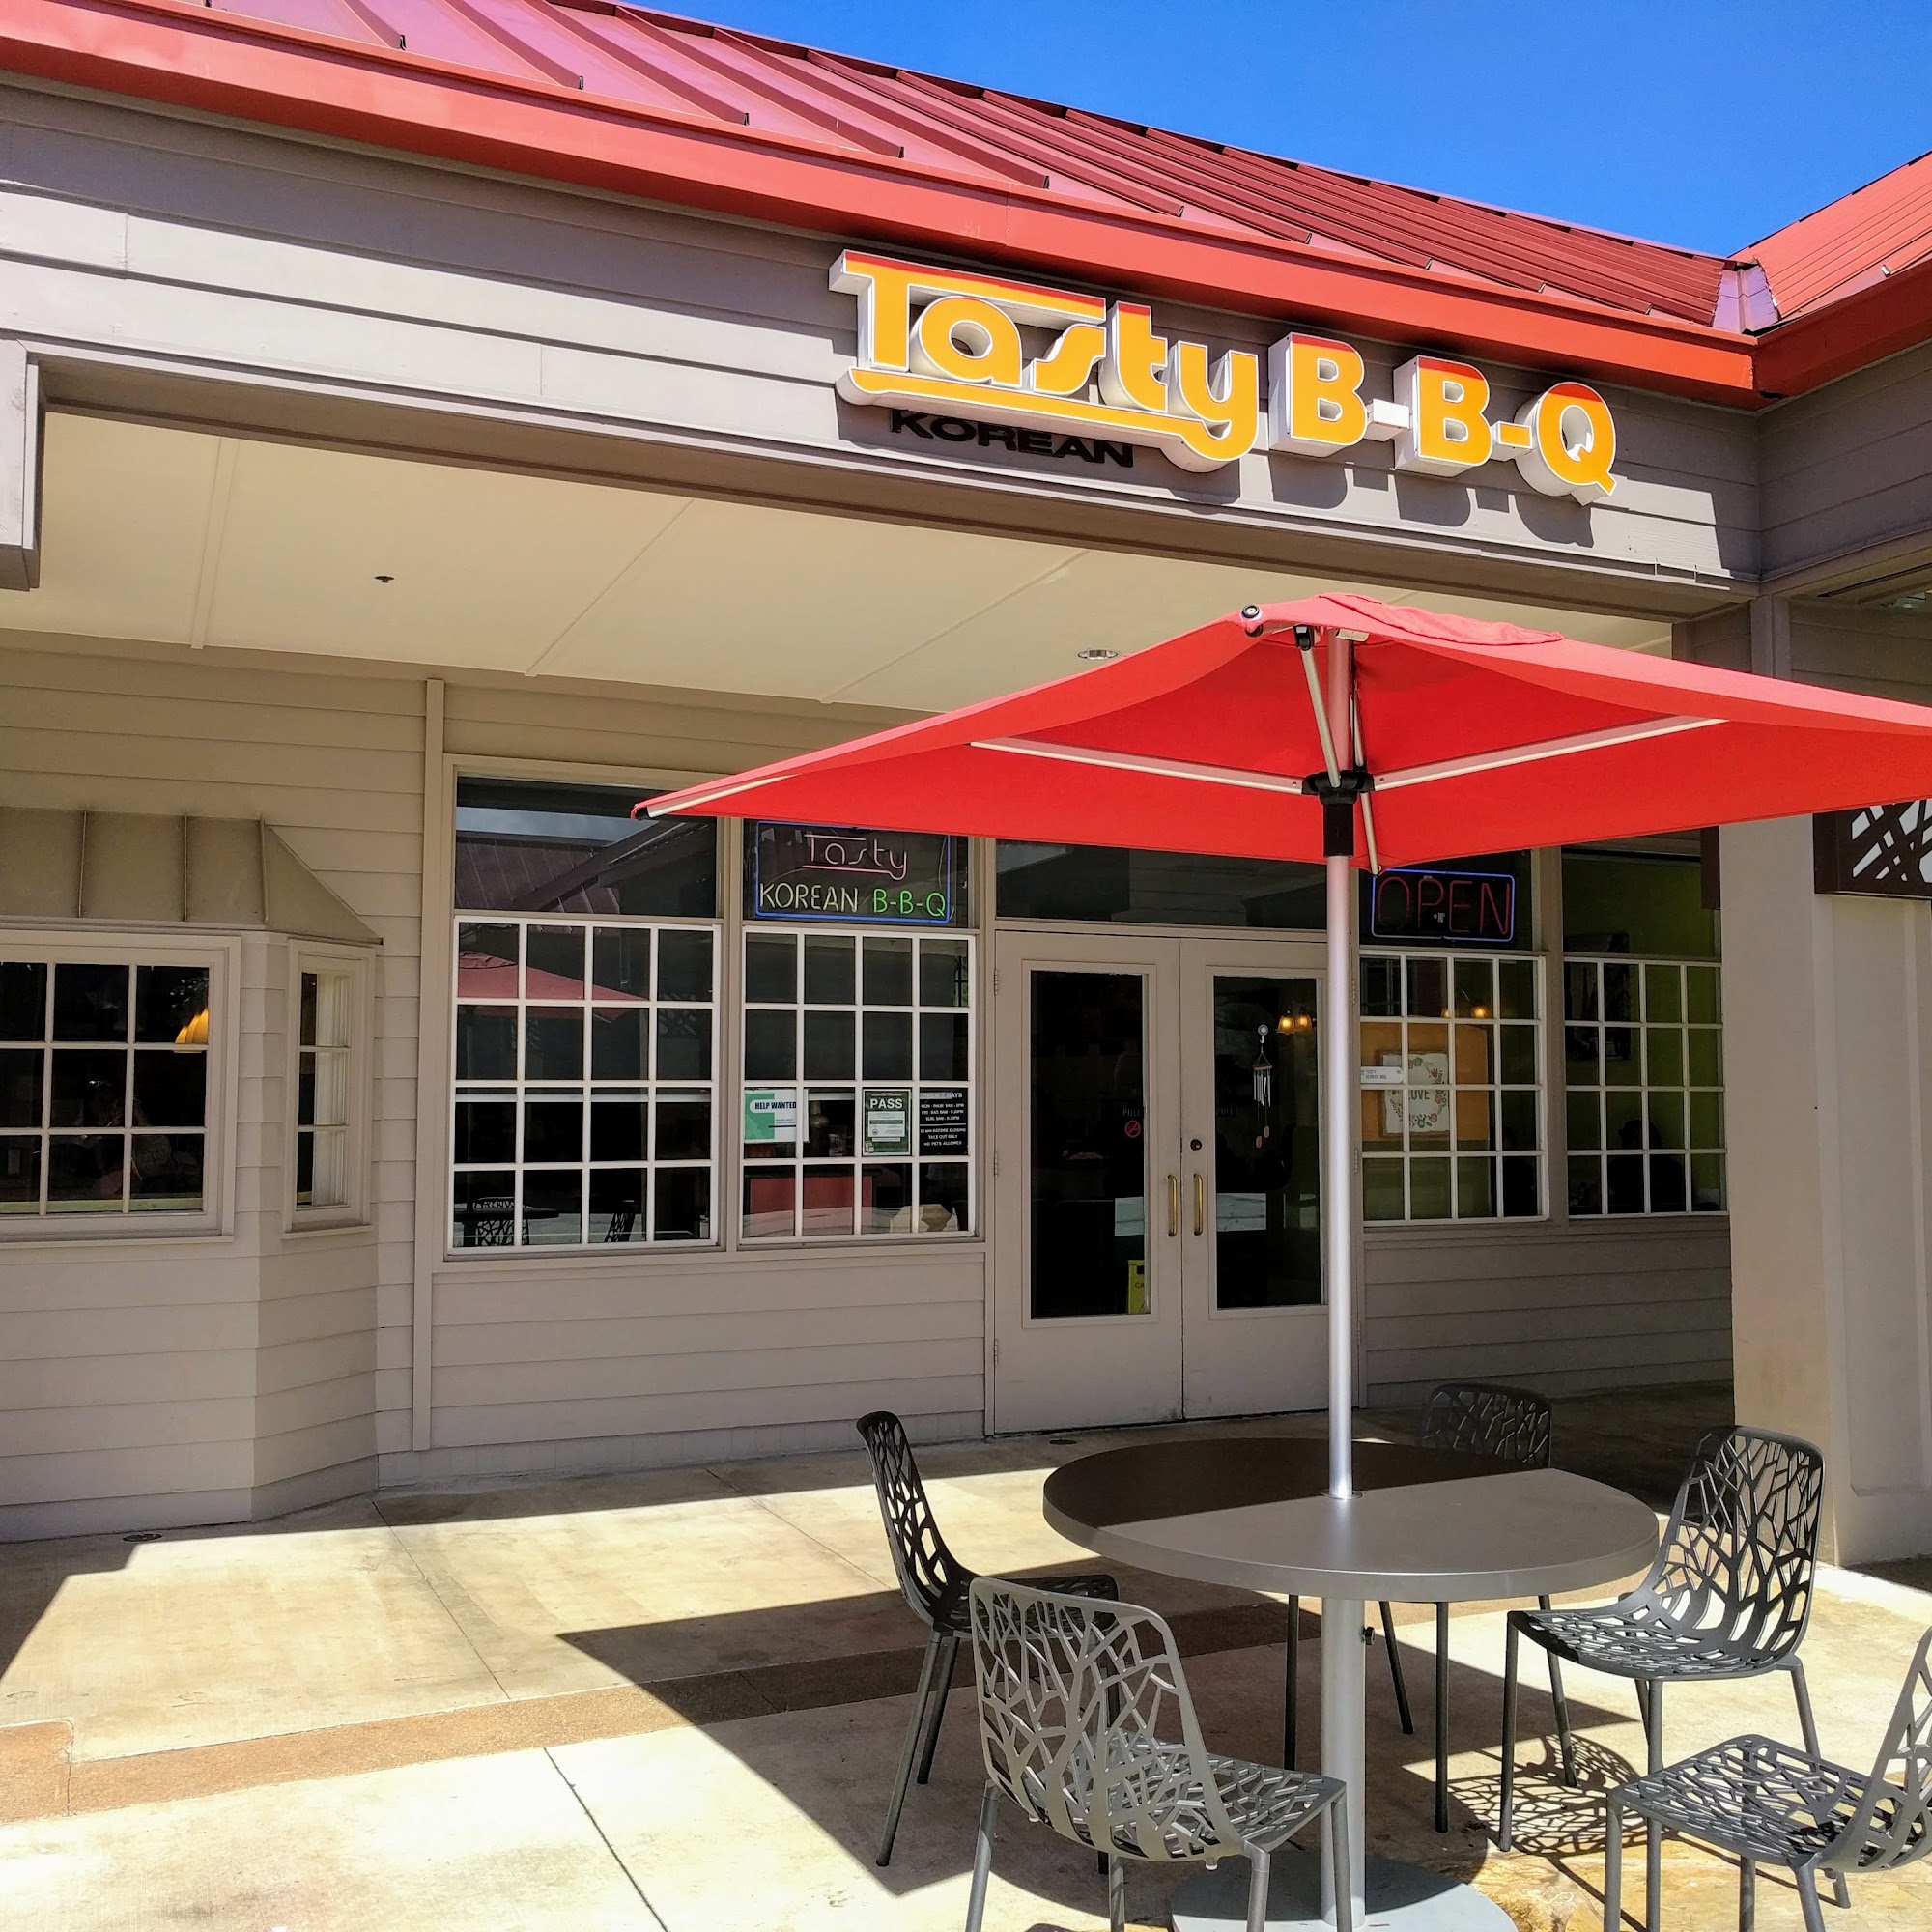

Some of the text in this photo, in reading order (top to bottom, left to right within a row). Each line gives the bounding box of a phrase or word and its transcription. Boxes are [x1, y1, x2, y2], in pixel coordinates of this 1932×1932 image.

[838, 248, 1617, 497] Tasty B-B-Q
[890, 410, 1134, 468] KOREAN
[802, 833, 907, 881] Tasty
[759, 882, 946, 918] KOREAN B-B-Q
[1378, 875, 1511, 936] OPEN
[869, 1097, 903, 1109] PASS
[1408, 1089, 1431, 1100] OVE
